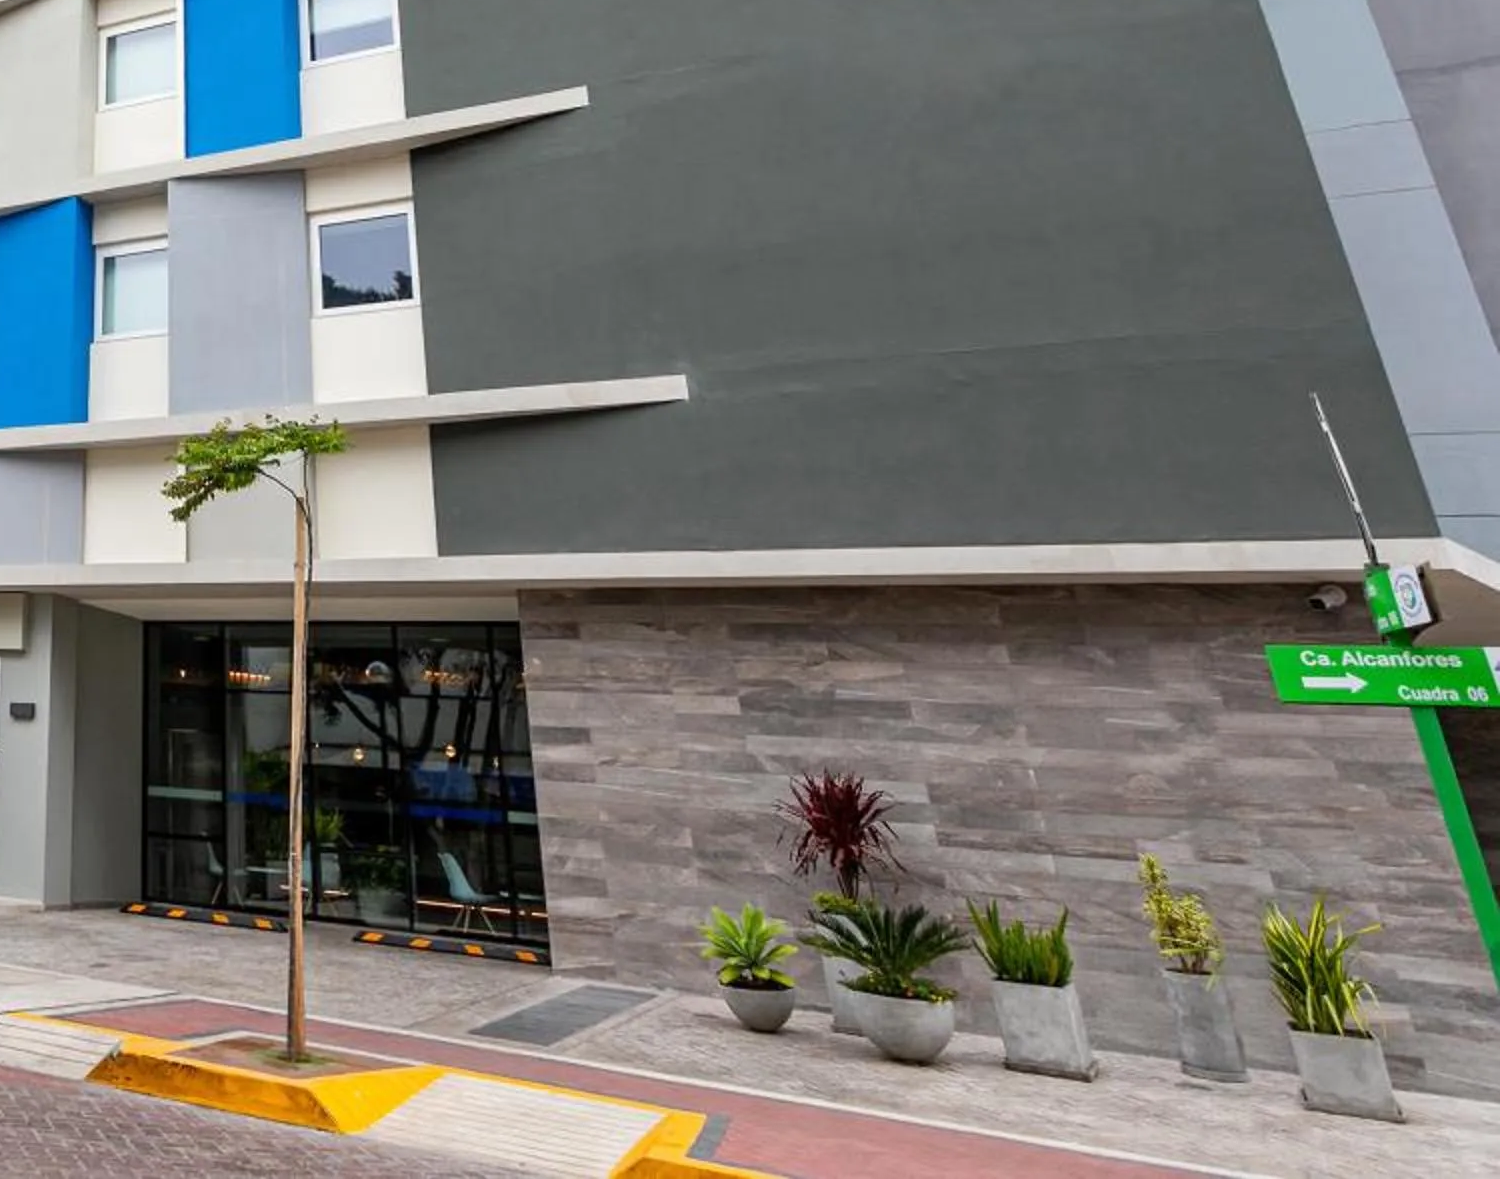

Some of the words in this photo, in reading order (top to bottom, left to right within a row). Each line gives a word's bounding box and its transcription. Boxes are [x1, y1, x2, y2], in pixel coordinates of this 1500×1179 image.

[1301, 650, 1336, 666] Ca.
[1342, 650, 1463, 668] Alcanfores
[1397, 685, 1459, 702] Cuadra
[1467, 686, 1489, 702] 06
